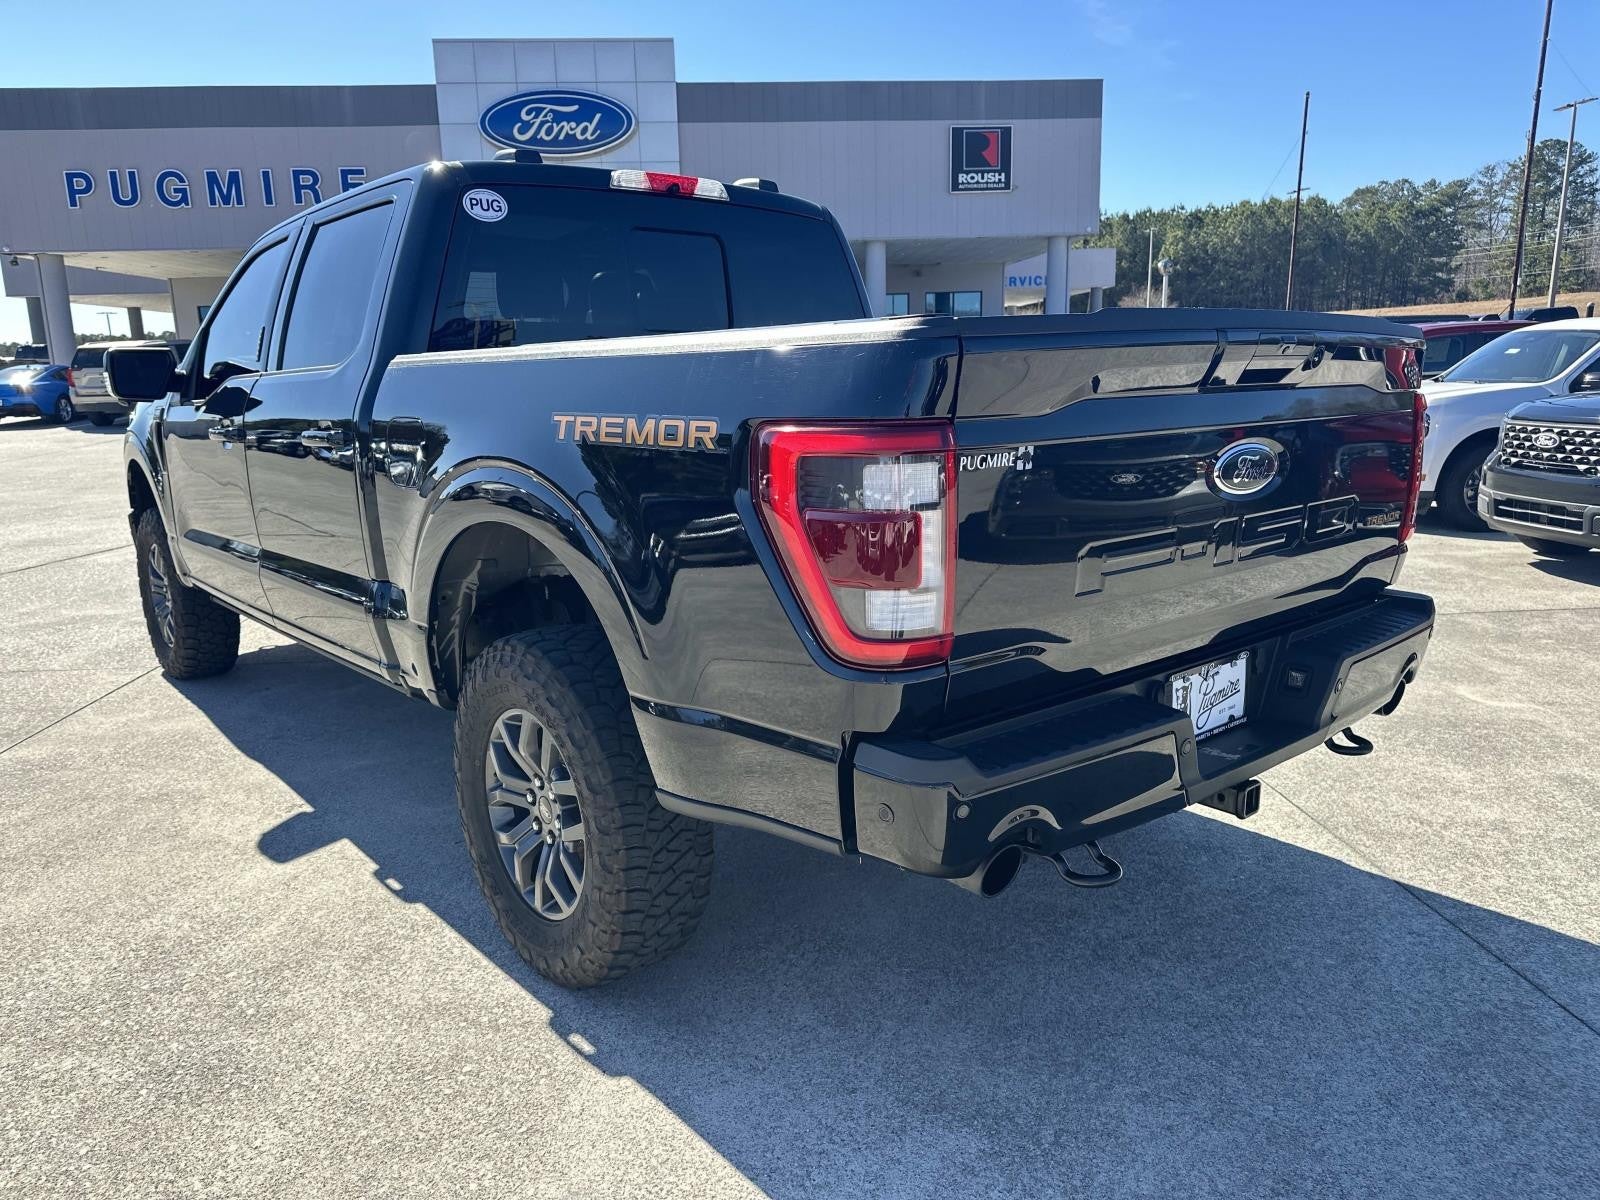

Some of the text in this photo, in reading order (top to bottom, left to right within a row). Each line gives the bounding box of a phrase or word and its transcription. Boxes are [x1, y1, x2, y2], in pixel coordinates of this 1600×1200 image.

[513, 103, 602, 141] Ford
[958, 172, 1006, 184] ROUSH
[469, 197, 503, 213] PUG
[1005, 275, 1047, 287] RVIC
[553, 414, 719, 450] TREMOR
[959, 452, 1016, 471] PUGMIRE
[1232, 455, 1275, 483] Ford
[1075, 494, 1359, 597] F-150
[1196, 671, 1241, 730] Pugmire
